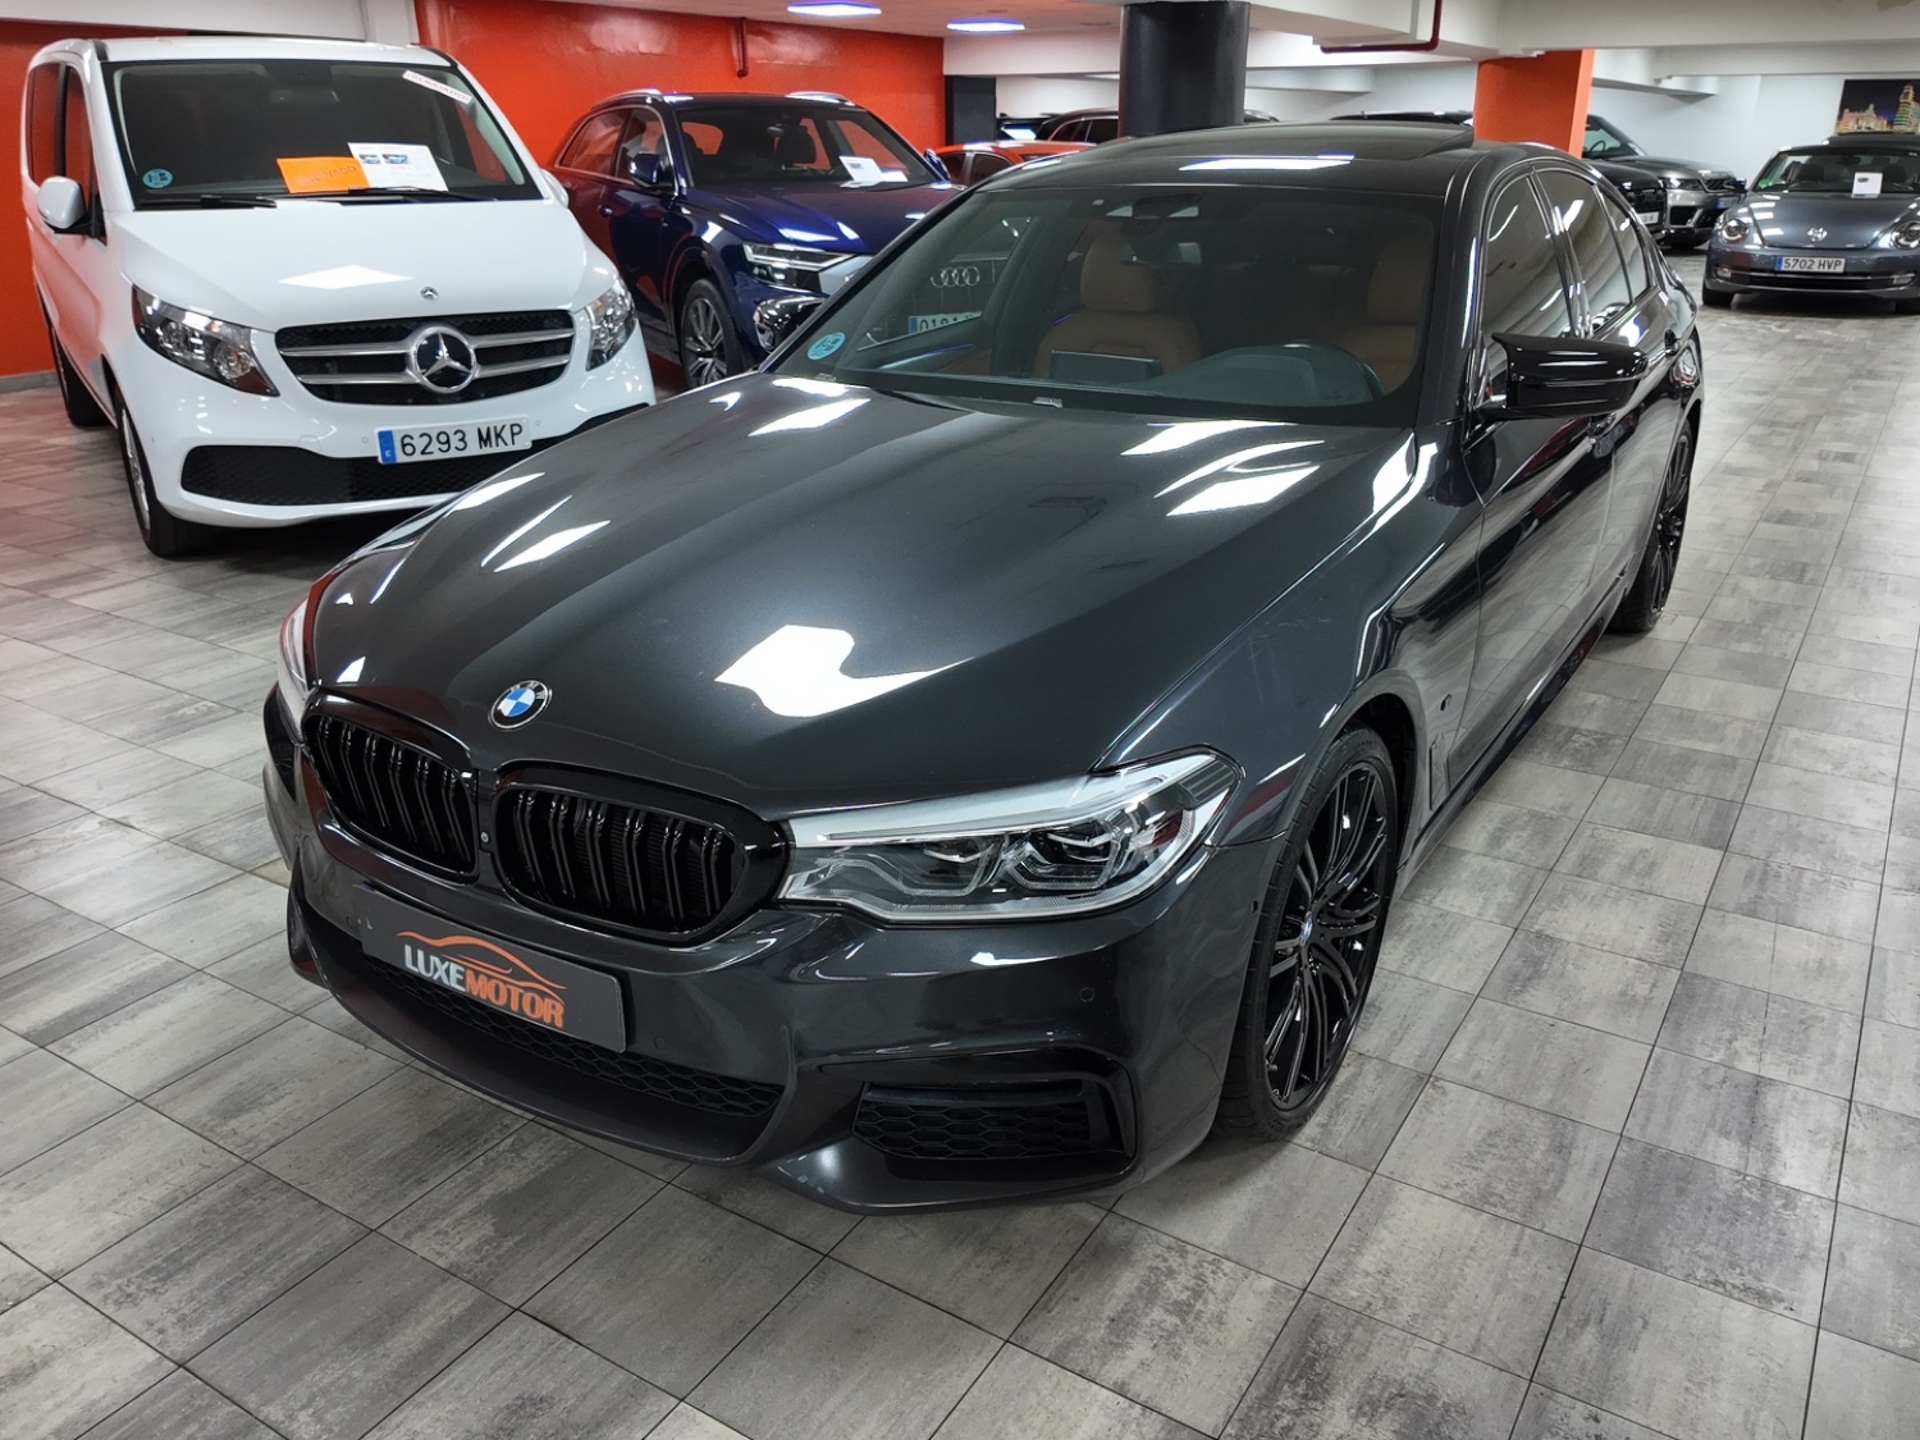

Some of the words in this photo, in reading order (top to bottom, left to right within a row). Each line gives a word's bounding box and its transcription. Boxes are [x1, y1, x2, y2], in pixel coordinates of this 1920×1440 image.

[1784, 258, 1815, 270] 5702
[1817, 259, 1842, 271] HVP
[400, 429, 468, 457] 6293
[477, 423, 523, 450] MKP
[404, 943, 565, 1029] LUXEMOTOR
